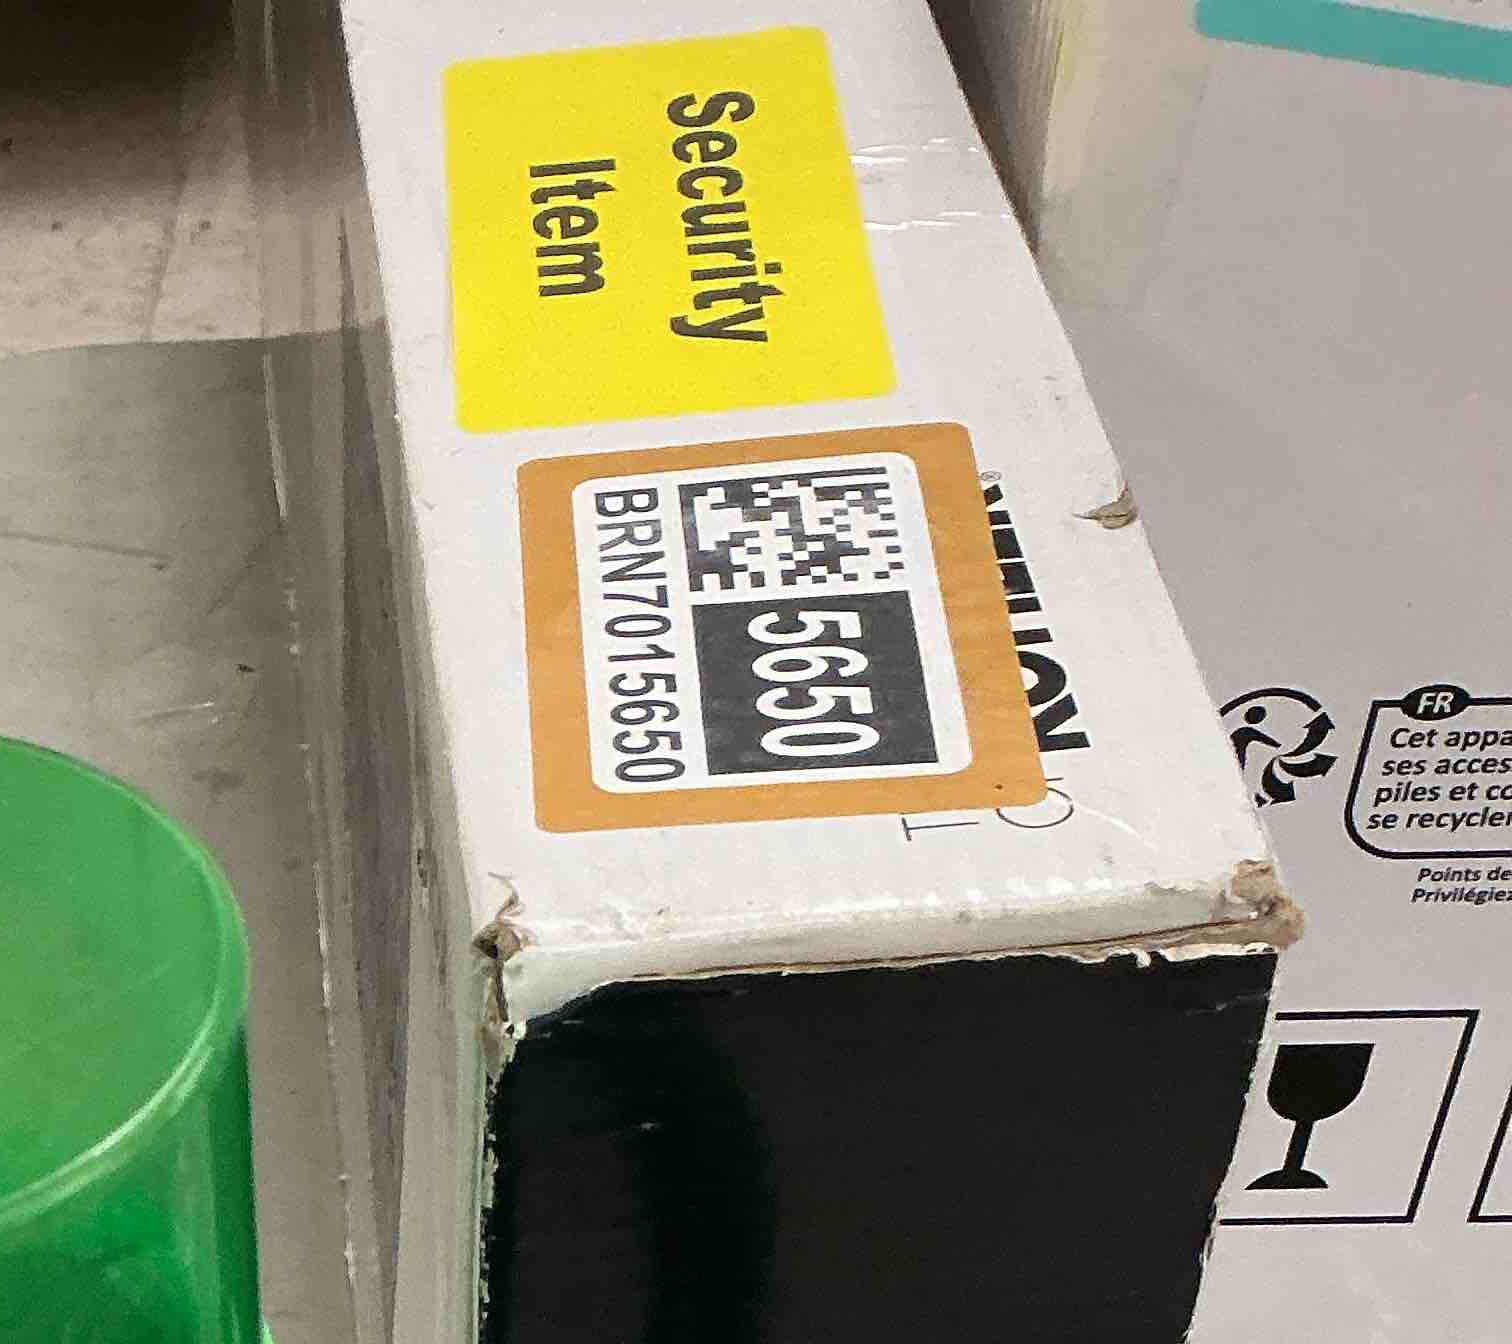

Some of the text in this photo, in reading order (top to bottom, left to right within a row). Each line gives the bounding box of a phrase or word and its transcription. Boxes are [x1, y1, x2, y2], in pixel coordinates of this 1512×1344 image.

[529, 158, 618, 299] Item
[666, 90, 790, 344] Security
[594, 486, 687, 784] BRN7015650
[746, 608, 881, 758] 5650
[1416, 691, 1455, 715] FR
[1390, 727, 1439, 749] Cet
[1381, 757, 1512, 777] ses acces
[1373, 780, 1441, 807] piles
[1448, 782, 1480, 801] et
[1367, 812, 1400, 830] se
[1417, 867, 1482, 883] Points
